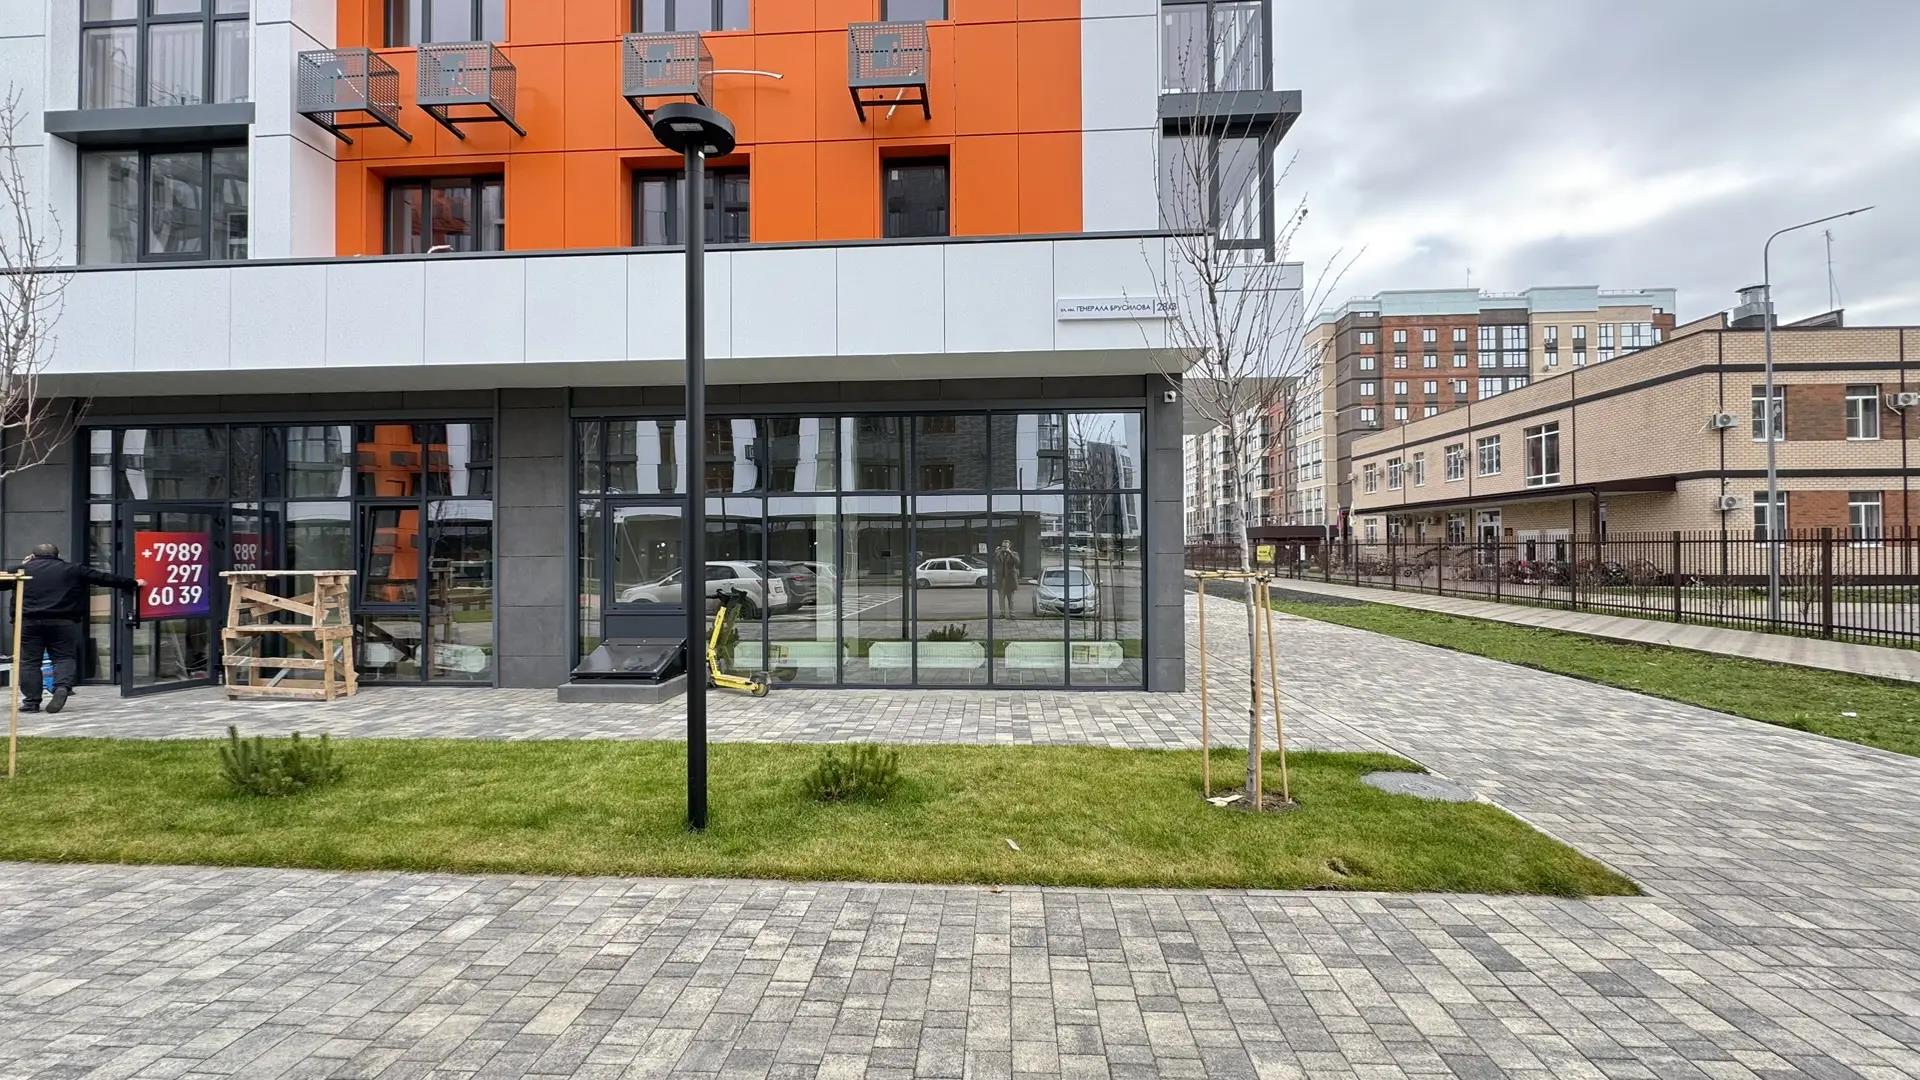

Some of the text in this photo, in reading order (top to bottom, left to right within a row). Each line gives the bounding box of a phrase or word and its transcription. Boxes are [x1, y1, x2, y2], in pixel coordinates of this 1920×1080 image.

[1110, 304, 1151, 312] БРУСИЛОВА
[141, 542, 202, 562] +7989
[166, 564, 203, 584] 297
[148, 585, 203, 606] 60 39
